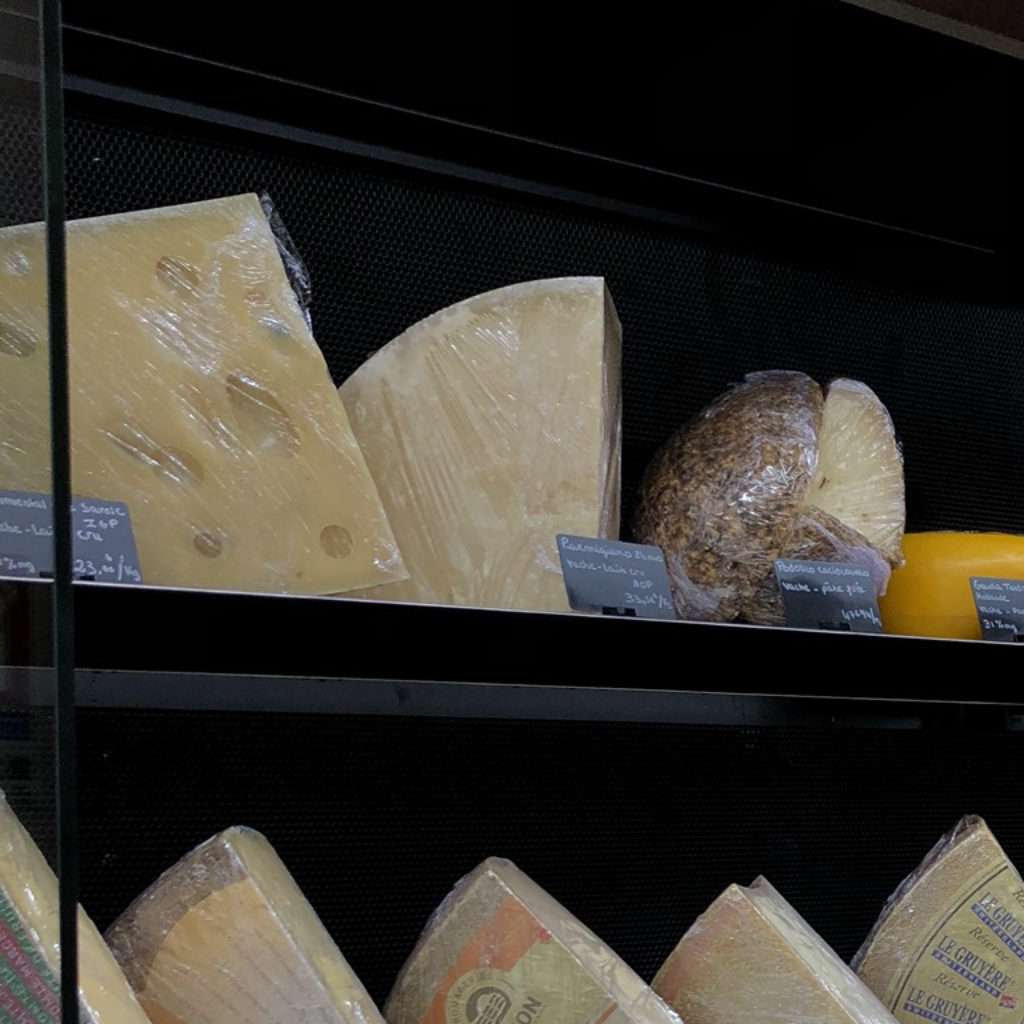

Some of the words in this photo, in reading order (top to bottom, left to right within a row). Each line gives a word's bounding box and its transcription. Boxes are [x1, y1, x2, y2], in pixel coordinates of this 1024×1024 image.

[968, 926, 1011, 963] Réserve
[938, 936, 956, 951] LE
[951, 944, 1013, 993] GRUYÈRE
[908, 987, 922, 1003] LE
[933, 972, 982, 1000] Réserve
